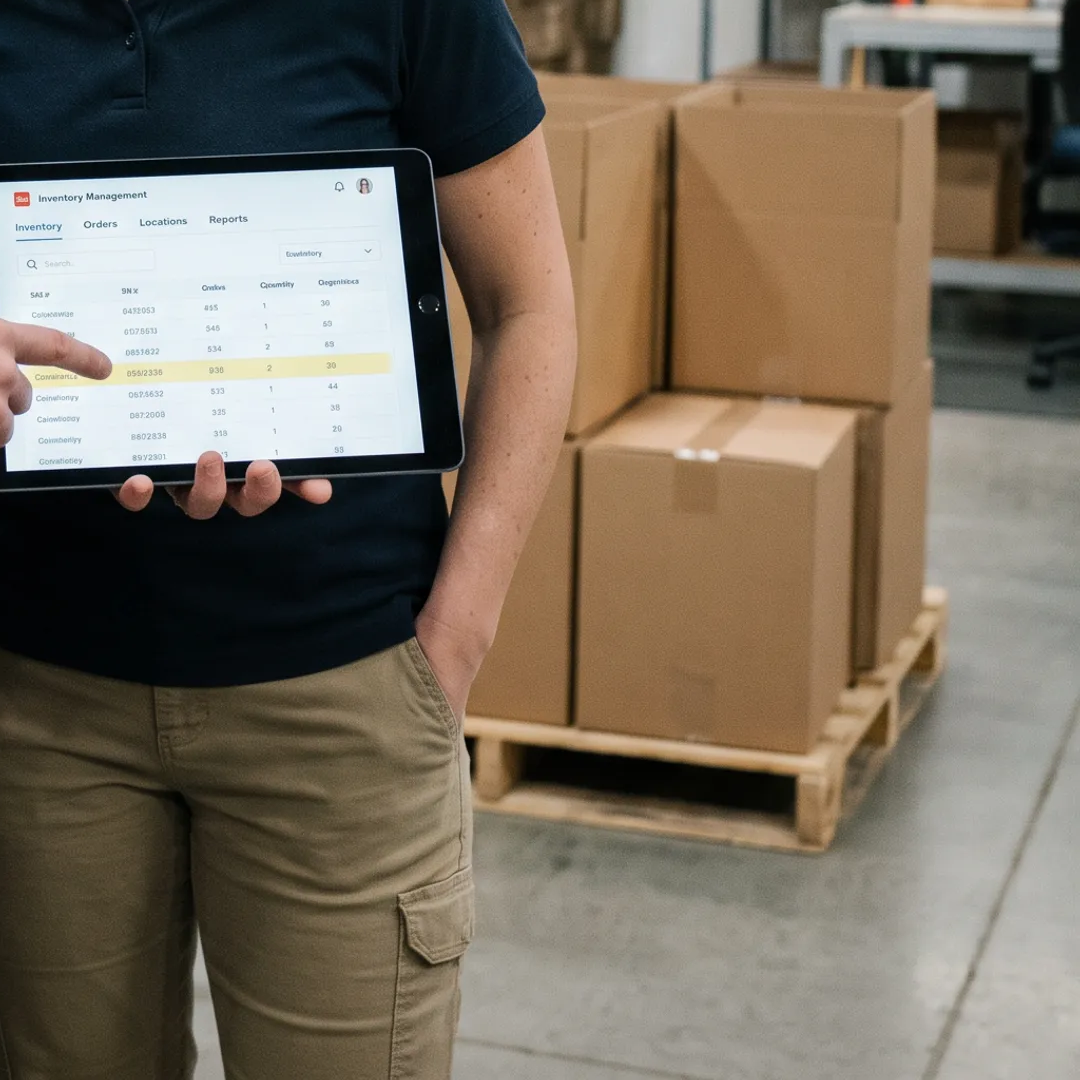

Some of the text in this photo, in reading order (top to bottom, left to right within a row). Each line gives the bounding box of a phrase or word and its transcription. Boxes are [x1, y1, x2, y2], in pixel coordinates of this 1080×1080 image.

[38, 193, 84, 203] Inventory
[86, 190, 148, 202] Management
[15, 214, 249, 233] Inventory Orders Locations Reports
[327, 382, 338, 390] 44
